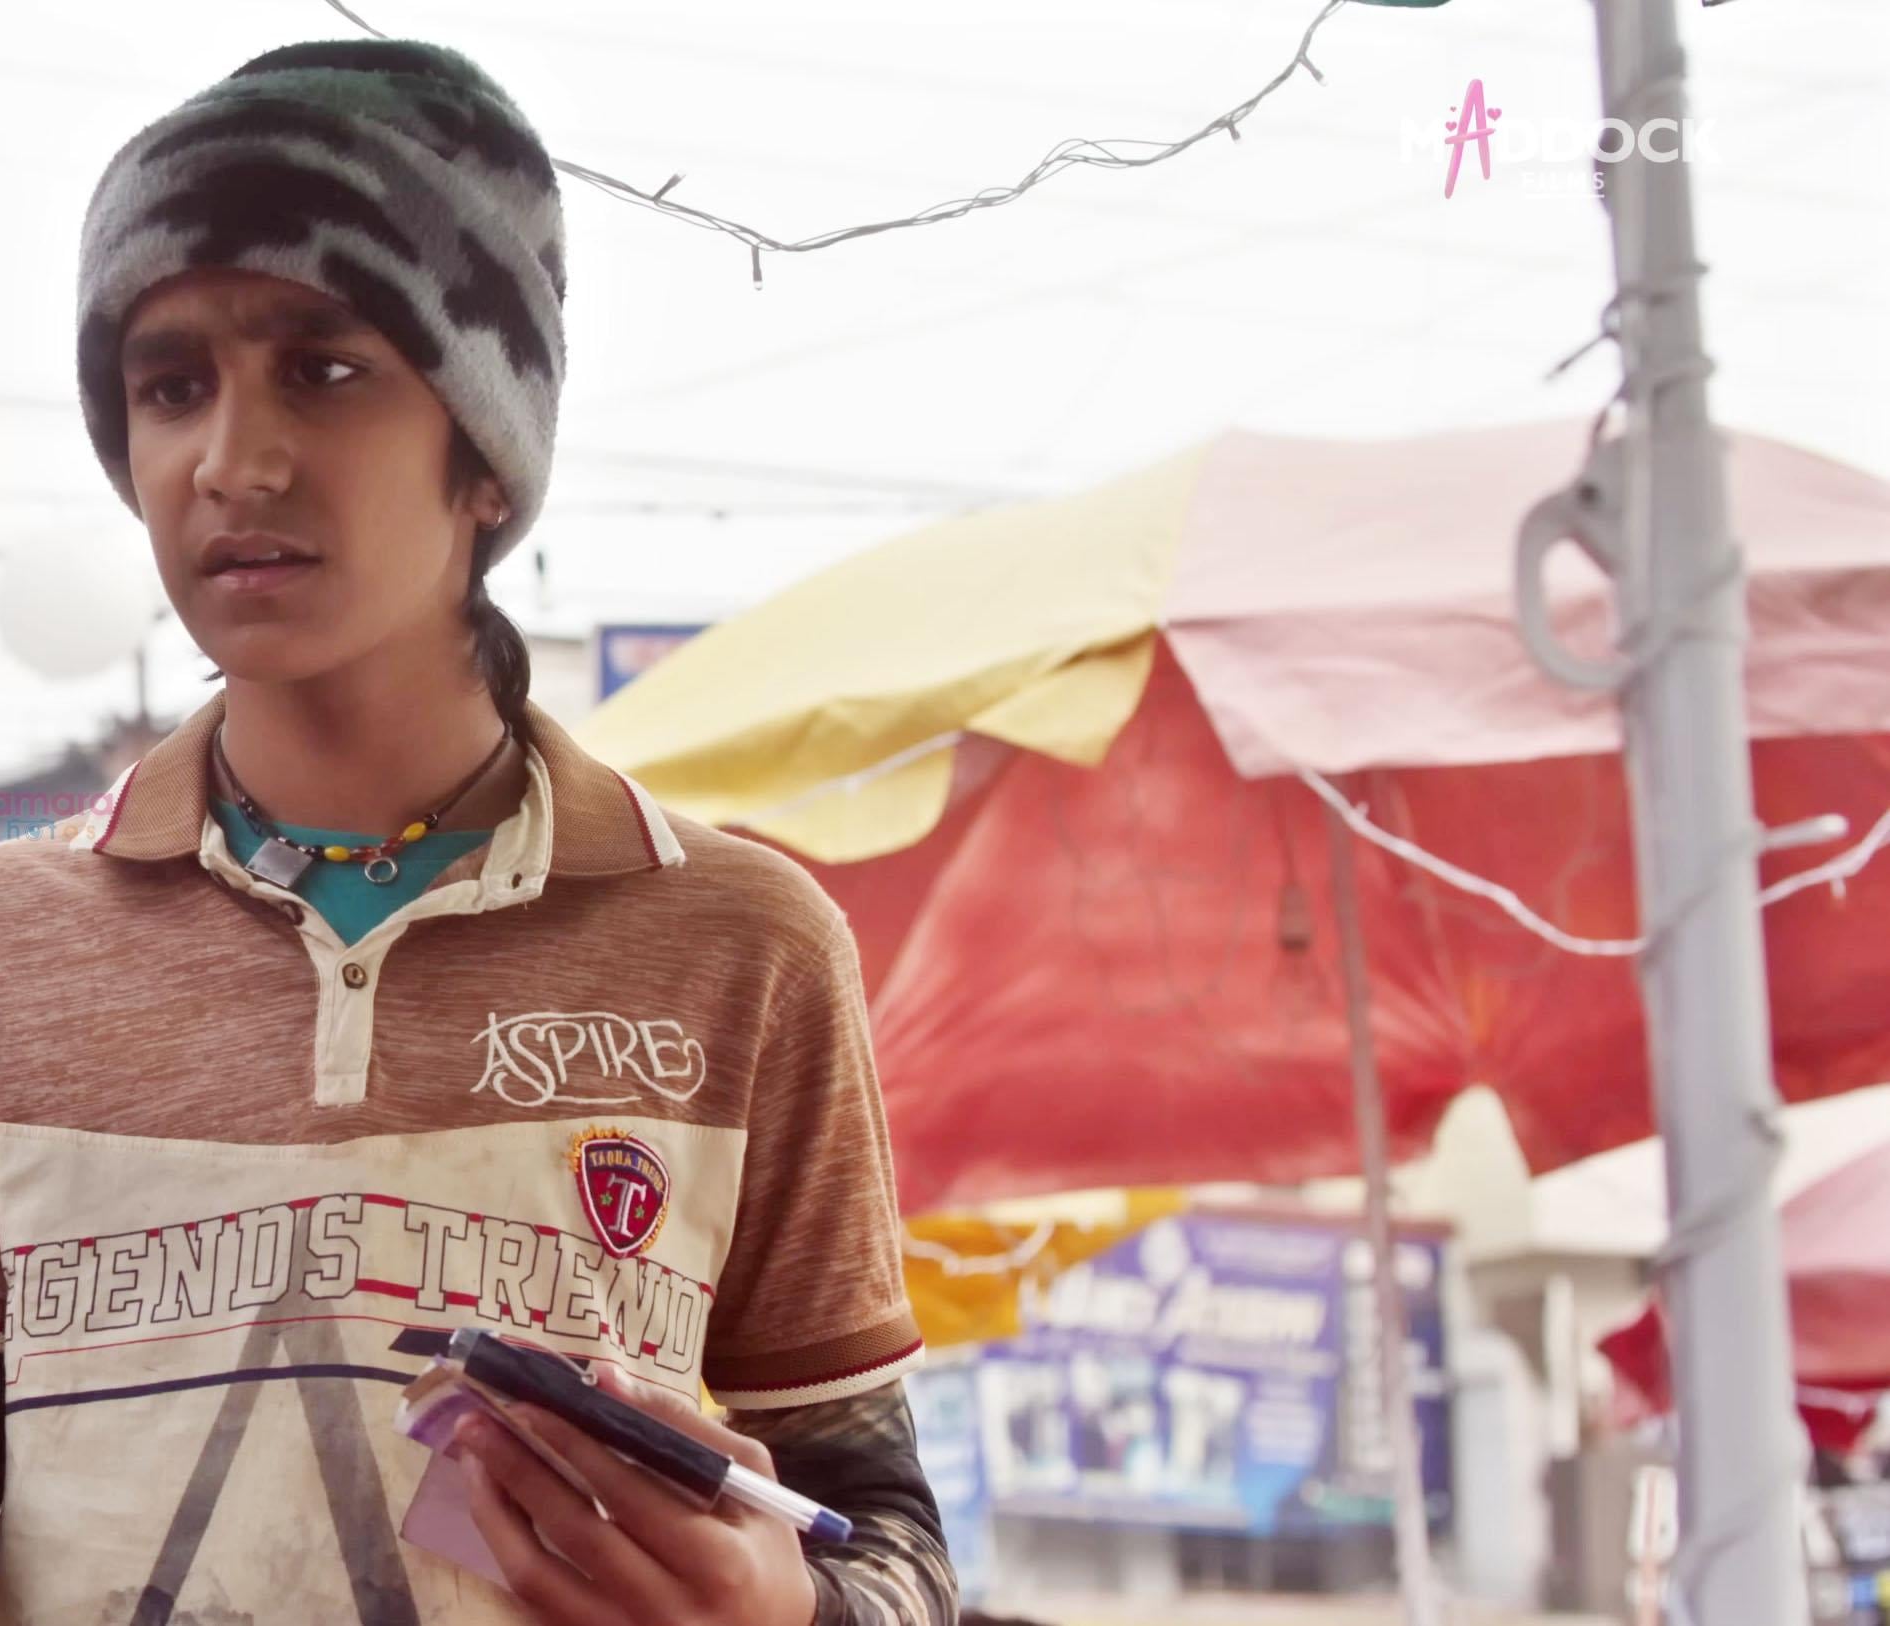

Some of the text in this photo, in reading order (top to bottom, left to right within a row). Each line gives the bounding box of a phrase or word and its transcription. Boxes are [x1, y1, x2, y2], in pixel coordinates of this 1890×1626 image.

[470, 1012, 706, 1107] ASPIRE
[607, 1172, 647, 1239] T
[404, 1200, 704, 1375] TREND
